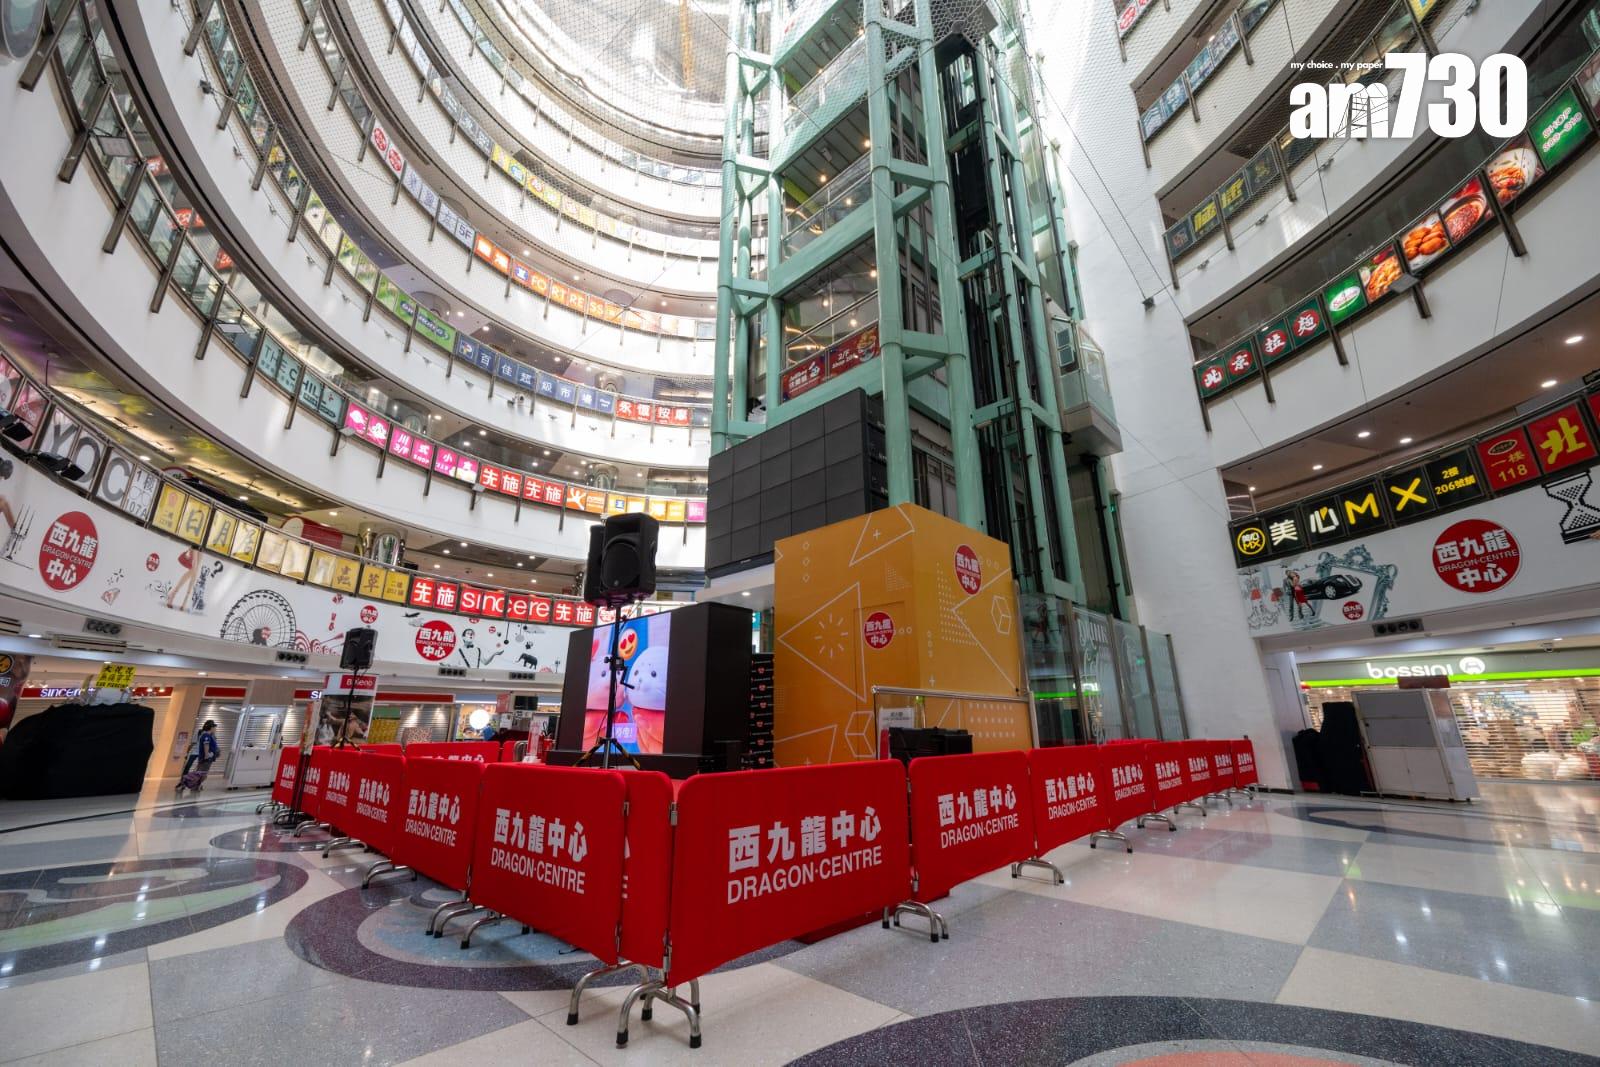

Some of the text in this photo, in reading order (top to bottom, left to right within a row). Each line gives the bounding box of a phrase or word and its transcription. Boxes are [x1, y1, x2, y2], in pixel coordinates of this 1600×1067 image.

[531, 275, 603, 314] FORTRESS
[264, 344, 288, 375] THE
[483, 467, 519, 494] 先施
[524, 481, 562, 504] 先施
[1498, 464, 1528, 482] 118
[48, 521, 98, 559] 西九龍
[1435, 528, 1511, 564] 西九龍
[46, 558, 77, 585] 中心
[1456, 562, 1508, 588] 中心
[414, 581, 455, 608] 先施
[462, 590, 550, 618] sincere
[555, 603, 593, 623] 先施
[419, 628, 454, 642] 西九龍
[423, 646, 446, 658] 中心
[1366, 662, 1454, 679] bossini
[1045, 772, 1095, 804] 西九龍中心
[408, 788, 460, 825] 西九龍中心
[937, 784, 1016, 828] 西九龍中心
[494, 808, 588, 863] 西九龍中心
[728, 806, 882, 874] 西九龍中心
